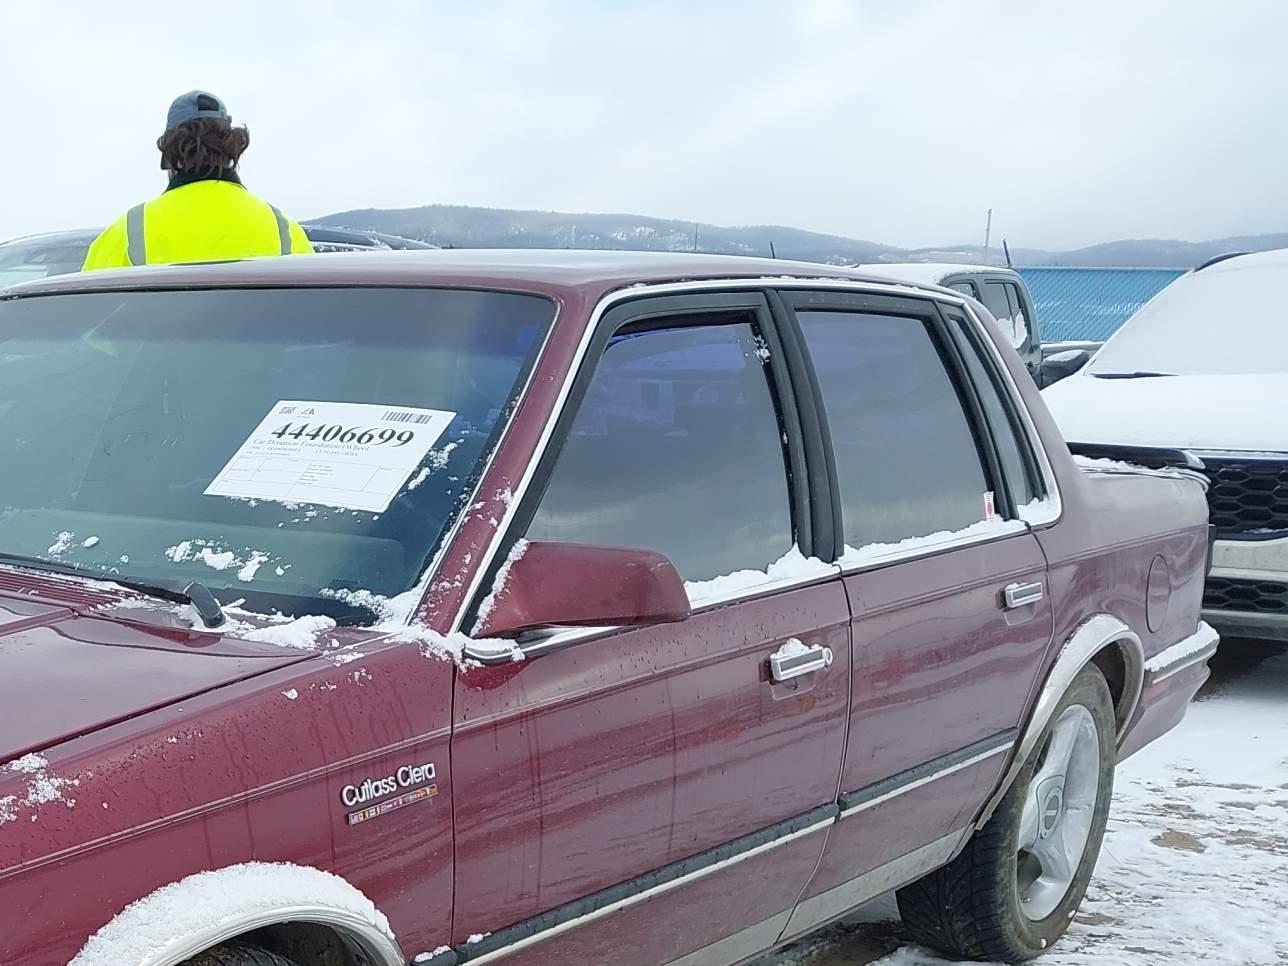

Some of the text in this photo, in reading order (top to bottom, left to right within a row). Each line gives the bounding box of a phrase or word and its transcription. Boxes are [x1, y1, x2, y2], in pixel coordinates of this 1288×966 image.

[271, 421, 415, 448] 44406699
[342, 762, 436, 806] Cutlass Ciera
